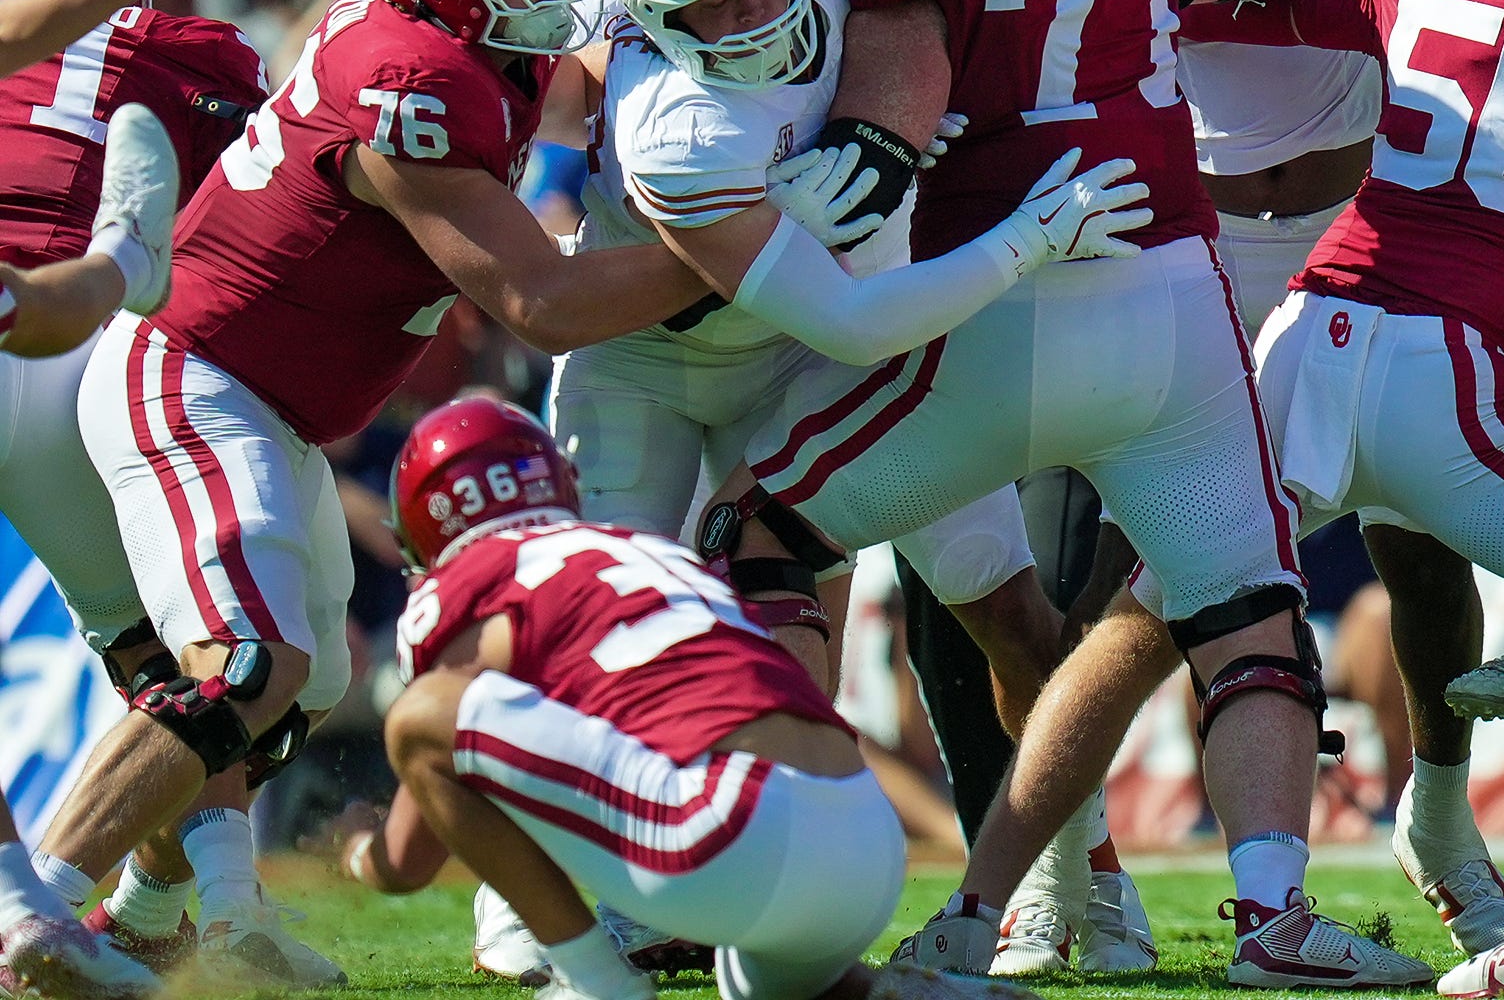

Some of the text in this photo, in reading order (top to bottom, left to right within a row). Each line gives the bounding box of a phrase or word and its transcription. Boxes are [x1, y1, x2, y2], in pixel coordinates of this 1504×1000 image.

[358, 88, 451, 160] 76
[1327, 310, 1353, 349] OU
[452, 462, 520, 517] 36
[935, 934, 948, 953] OU
